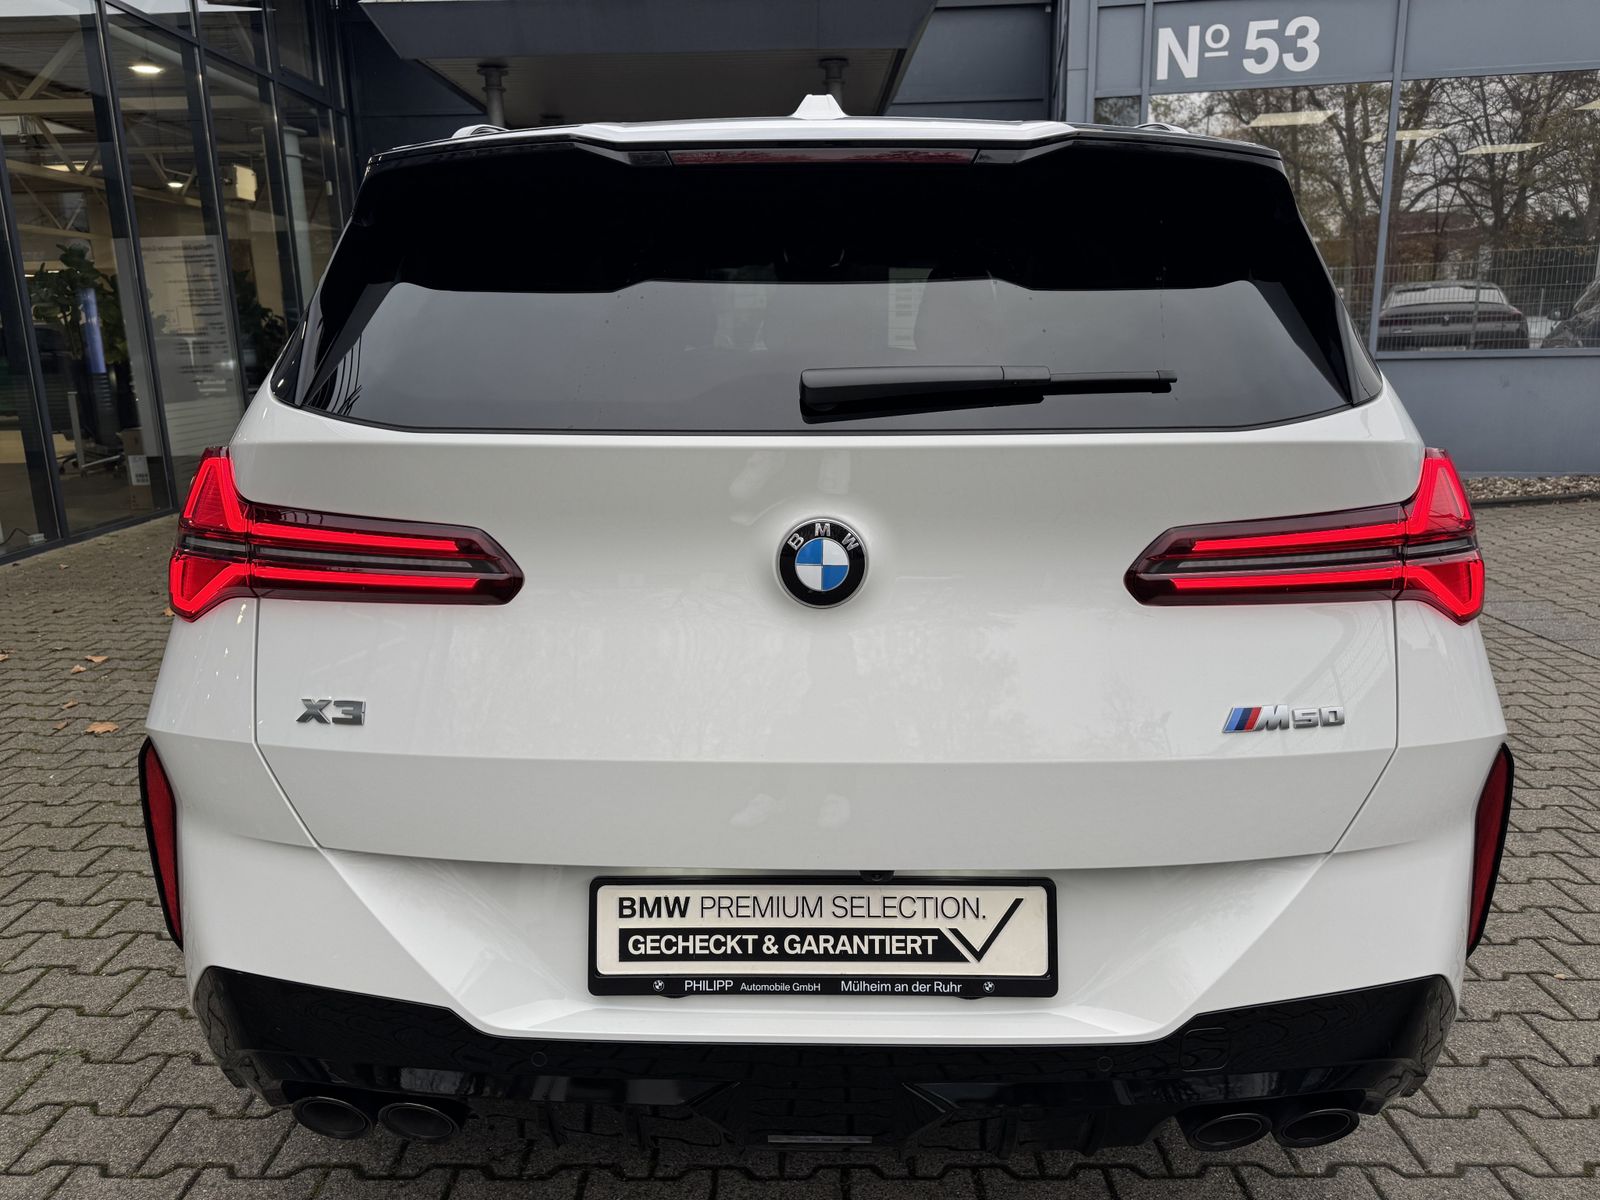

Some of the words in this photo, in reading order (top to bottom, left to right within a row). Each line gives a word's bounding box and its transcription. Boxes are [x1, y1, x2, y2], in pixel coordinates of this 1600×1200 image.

[1242, 15, 1321, 75] 53
[786, 522, 860, 552] BMW
[295, 698, 367, 726] X3
[1252, 704, 1346, 733] M50
[618, 896, 691, 919] BMW
[700, 895, 823, 919] PREMIUM
[831, 895, 987, 920] SELECTION.
[627, 934, 759, 955] GECHECKT
[762, 934, 779, 955] &
[783, 934, 939, 955] GARANTIERT
[683, 979, 734, 992] PHILIPP
[739, 981, 791, 992] Automobile
[792, 982, 821, 992] GmbH
[840, 980, 892, 993] Mülheim
[894, 983, 909, 993] an
[911, 981, 931, 993] der
[933, 981, 962, 994] Ruhr
